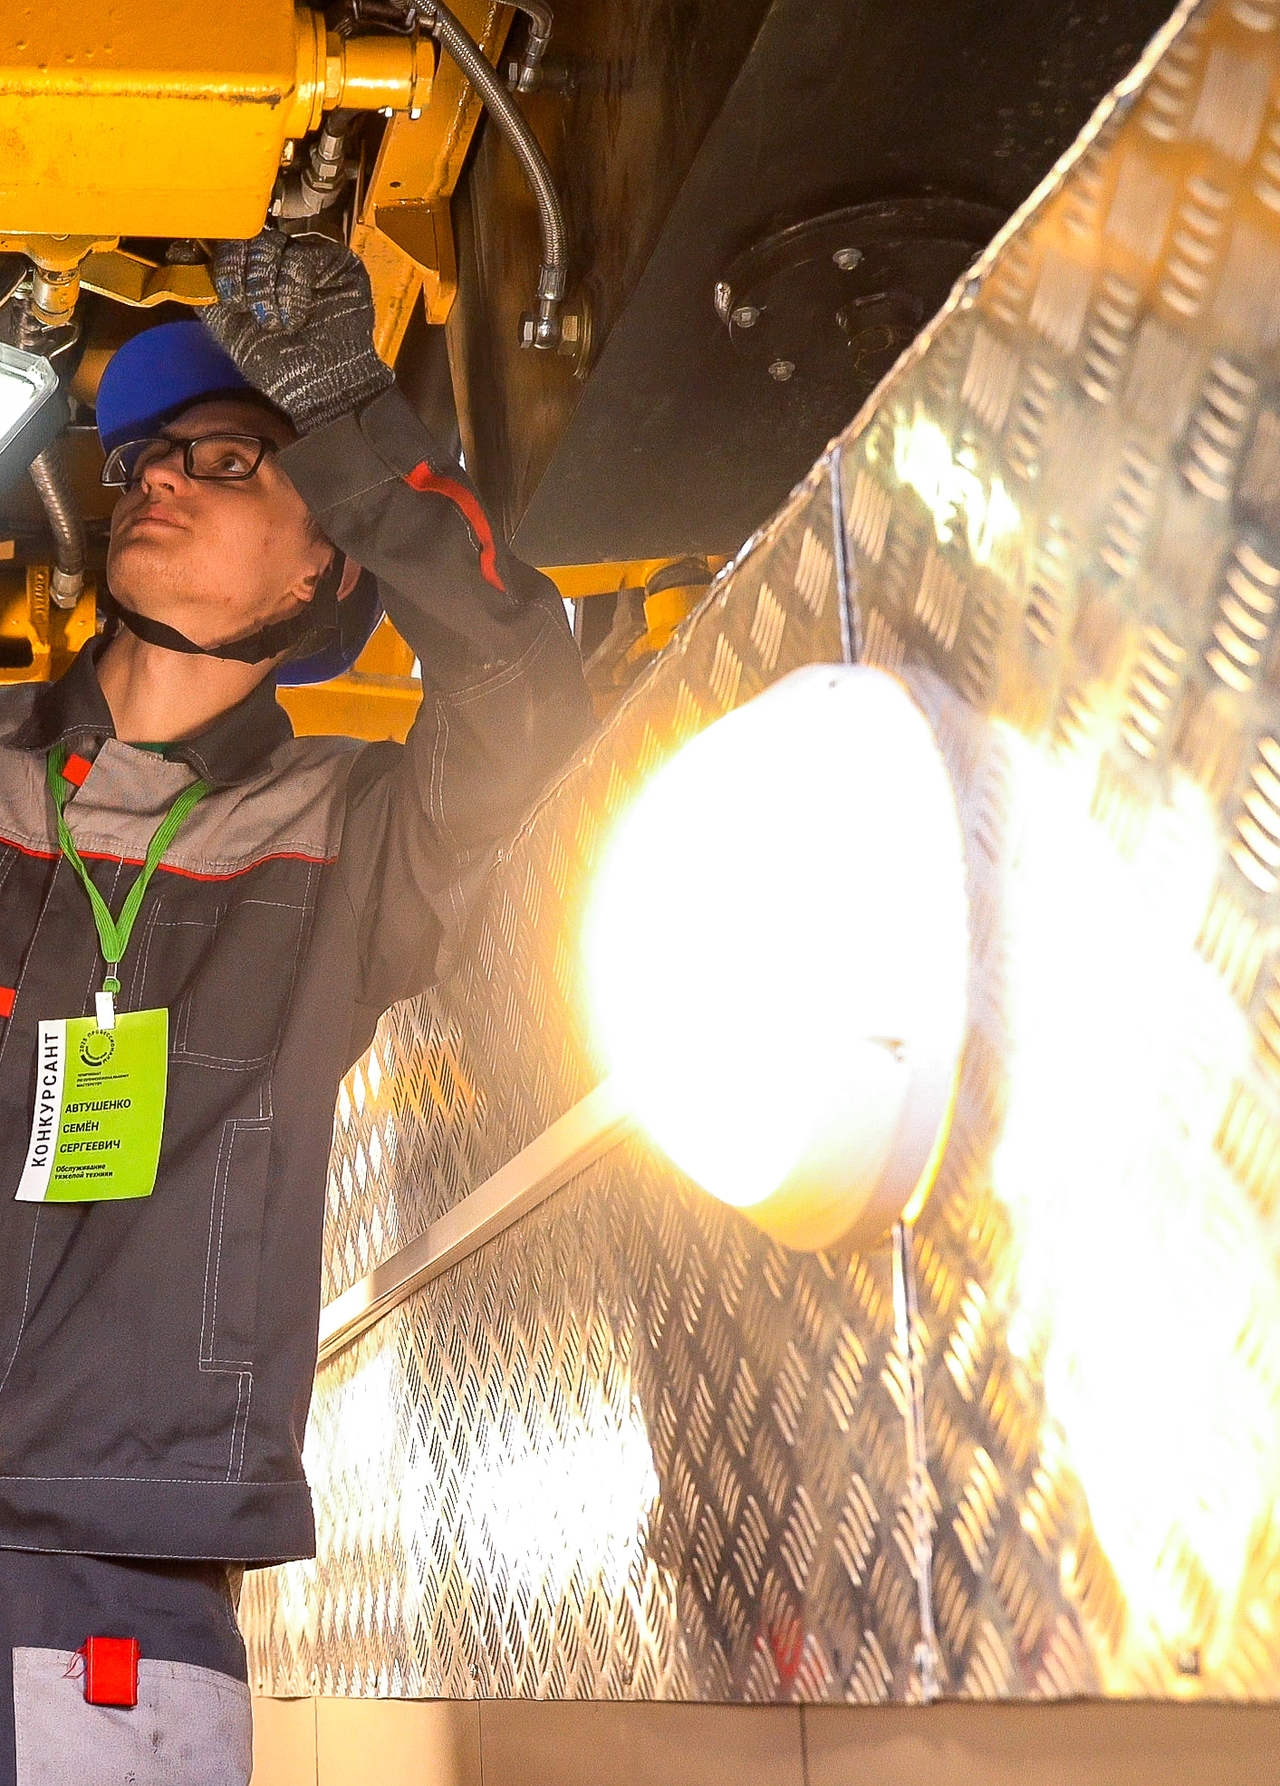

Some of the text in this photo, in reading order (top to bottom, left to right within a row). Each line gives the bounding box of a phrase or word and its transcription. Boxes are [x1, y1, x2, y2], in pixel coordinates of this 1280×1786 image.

[31, 1033, 59, 1167] КОНКУРСАНТ
[65, 1098, 131, 1113] АВТУШЕНКО
[63, 1120, 99, 1133] СЕМЁН
[60, 1139, 121, 1153] СЕРГЕЕВИЧ
[56, 1164, 106, 1173] Обслуживание
[85, 1171, 113, 1179] техники
